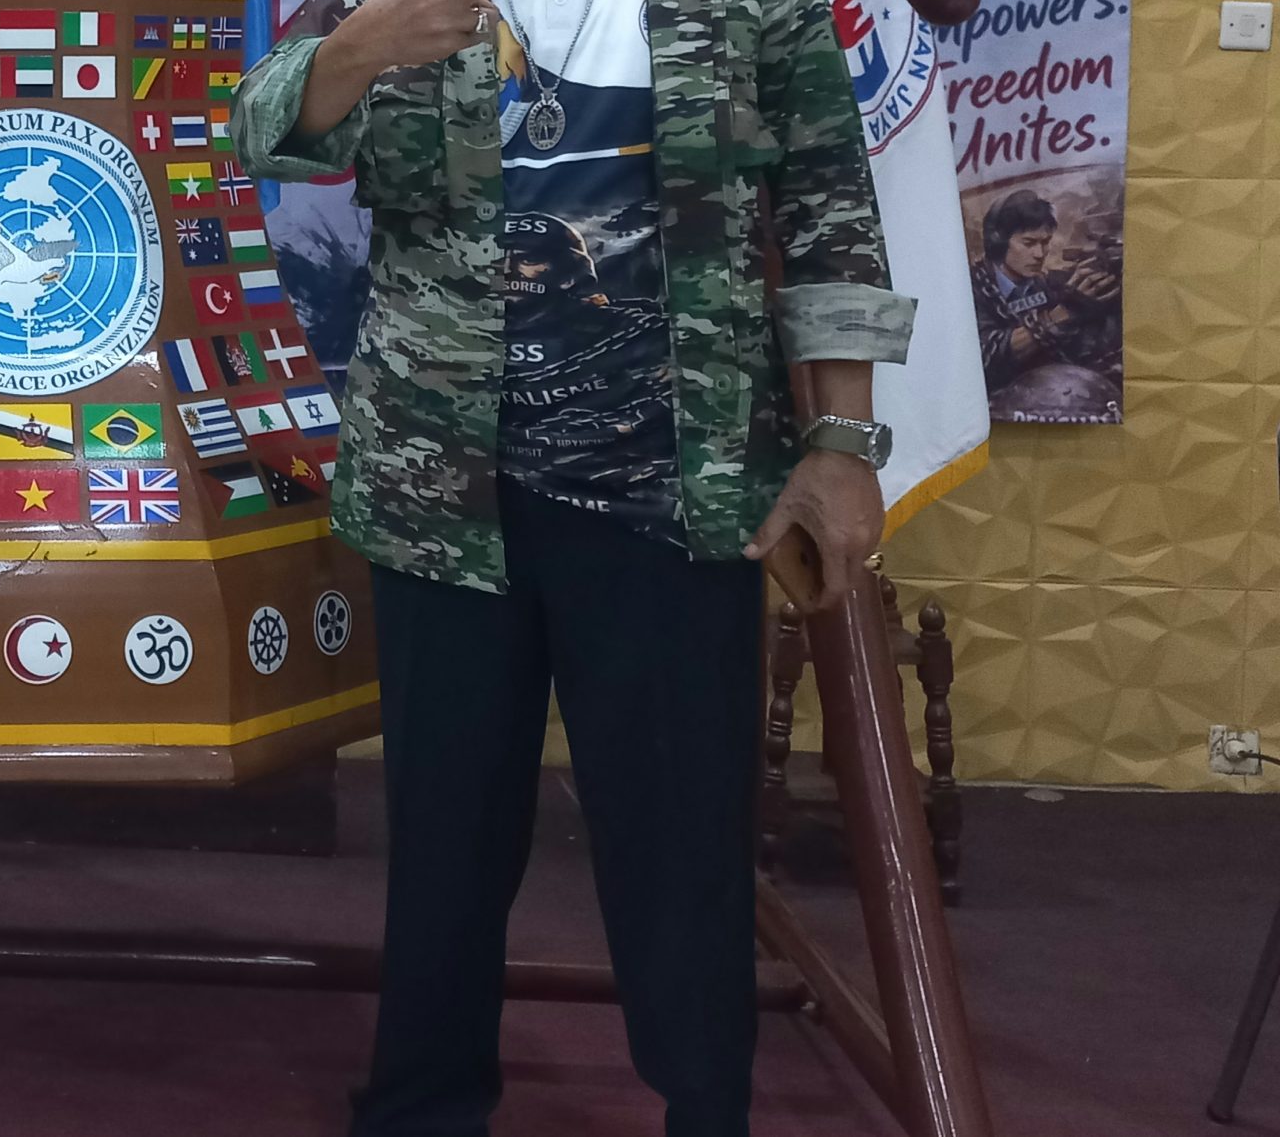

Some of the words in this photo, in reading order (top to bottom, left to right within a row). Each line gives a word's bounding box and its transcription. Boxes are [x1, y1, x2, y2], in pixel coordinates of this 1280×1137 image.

[938, 41, 1113, 114] reedom
[50, 113, 98, 146] PAX
[99, 138, 159, 245] ORGANUM
[504, 219, 548, 234] ESS
[504, 280, 546, 294] SORED
[51, 279, 161, 388] ORGANIZATION
